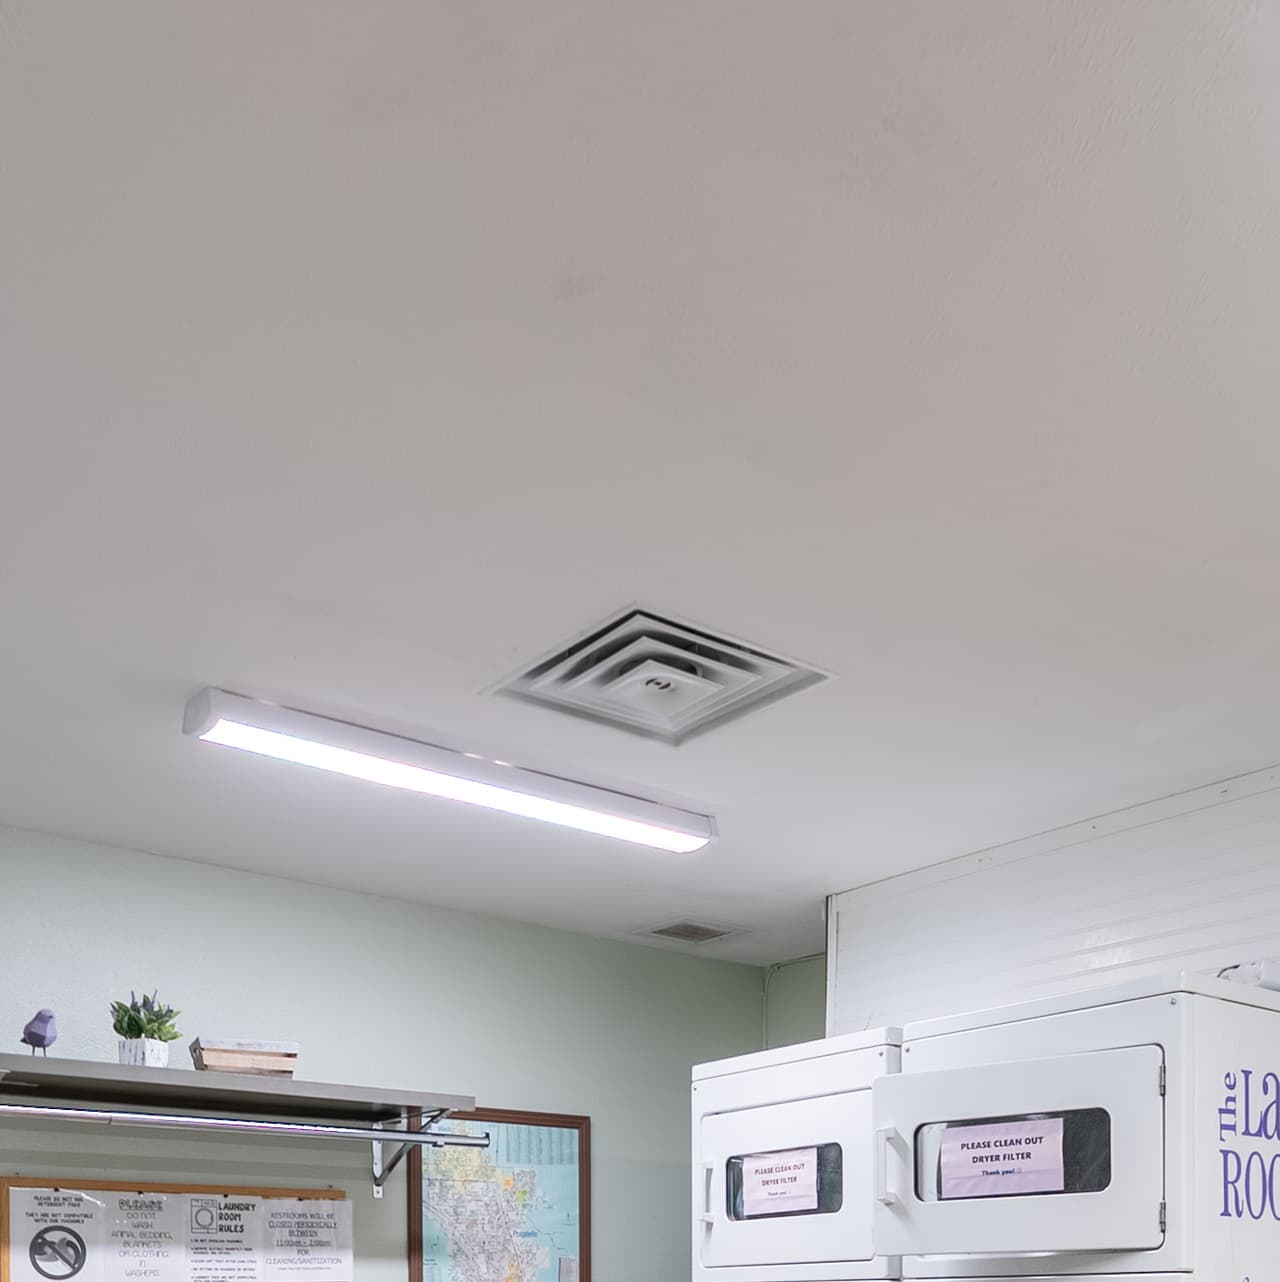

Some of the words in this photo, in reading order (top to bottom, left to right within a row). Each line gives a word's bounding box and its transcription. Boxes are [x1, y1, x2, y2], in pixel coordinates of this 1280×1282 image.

[1218, 1071, 1238, 1142] The
[961, 1141, 992, 1150] PLEASE
[993, 1138, 1022, 1148] CLEAN
[1024, 1136, 1044, 1146] OUT
[972, 1154, 1001, 1164] DRYER
[1002, 1151, 1032, 1162] FILTER
[754, 1166, 774, 1175] PLEASE
[775, 1164, 792, 1173] CLEAN
[793, 1163, 805, 1171] OUT
[761, 1177, 779, 1187] DRYER
[780, 1176, 797, 1185] FILTER
[218, 1202, 256, 1212] LAUNDRY
[218, 1212, 241, 1222] ROOM
[218, 1224, 245, 1234] RULES
[268, 1220, 293, 1229] CLOSED
